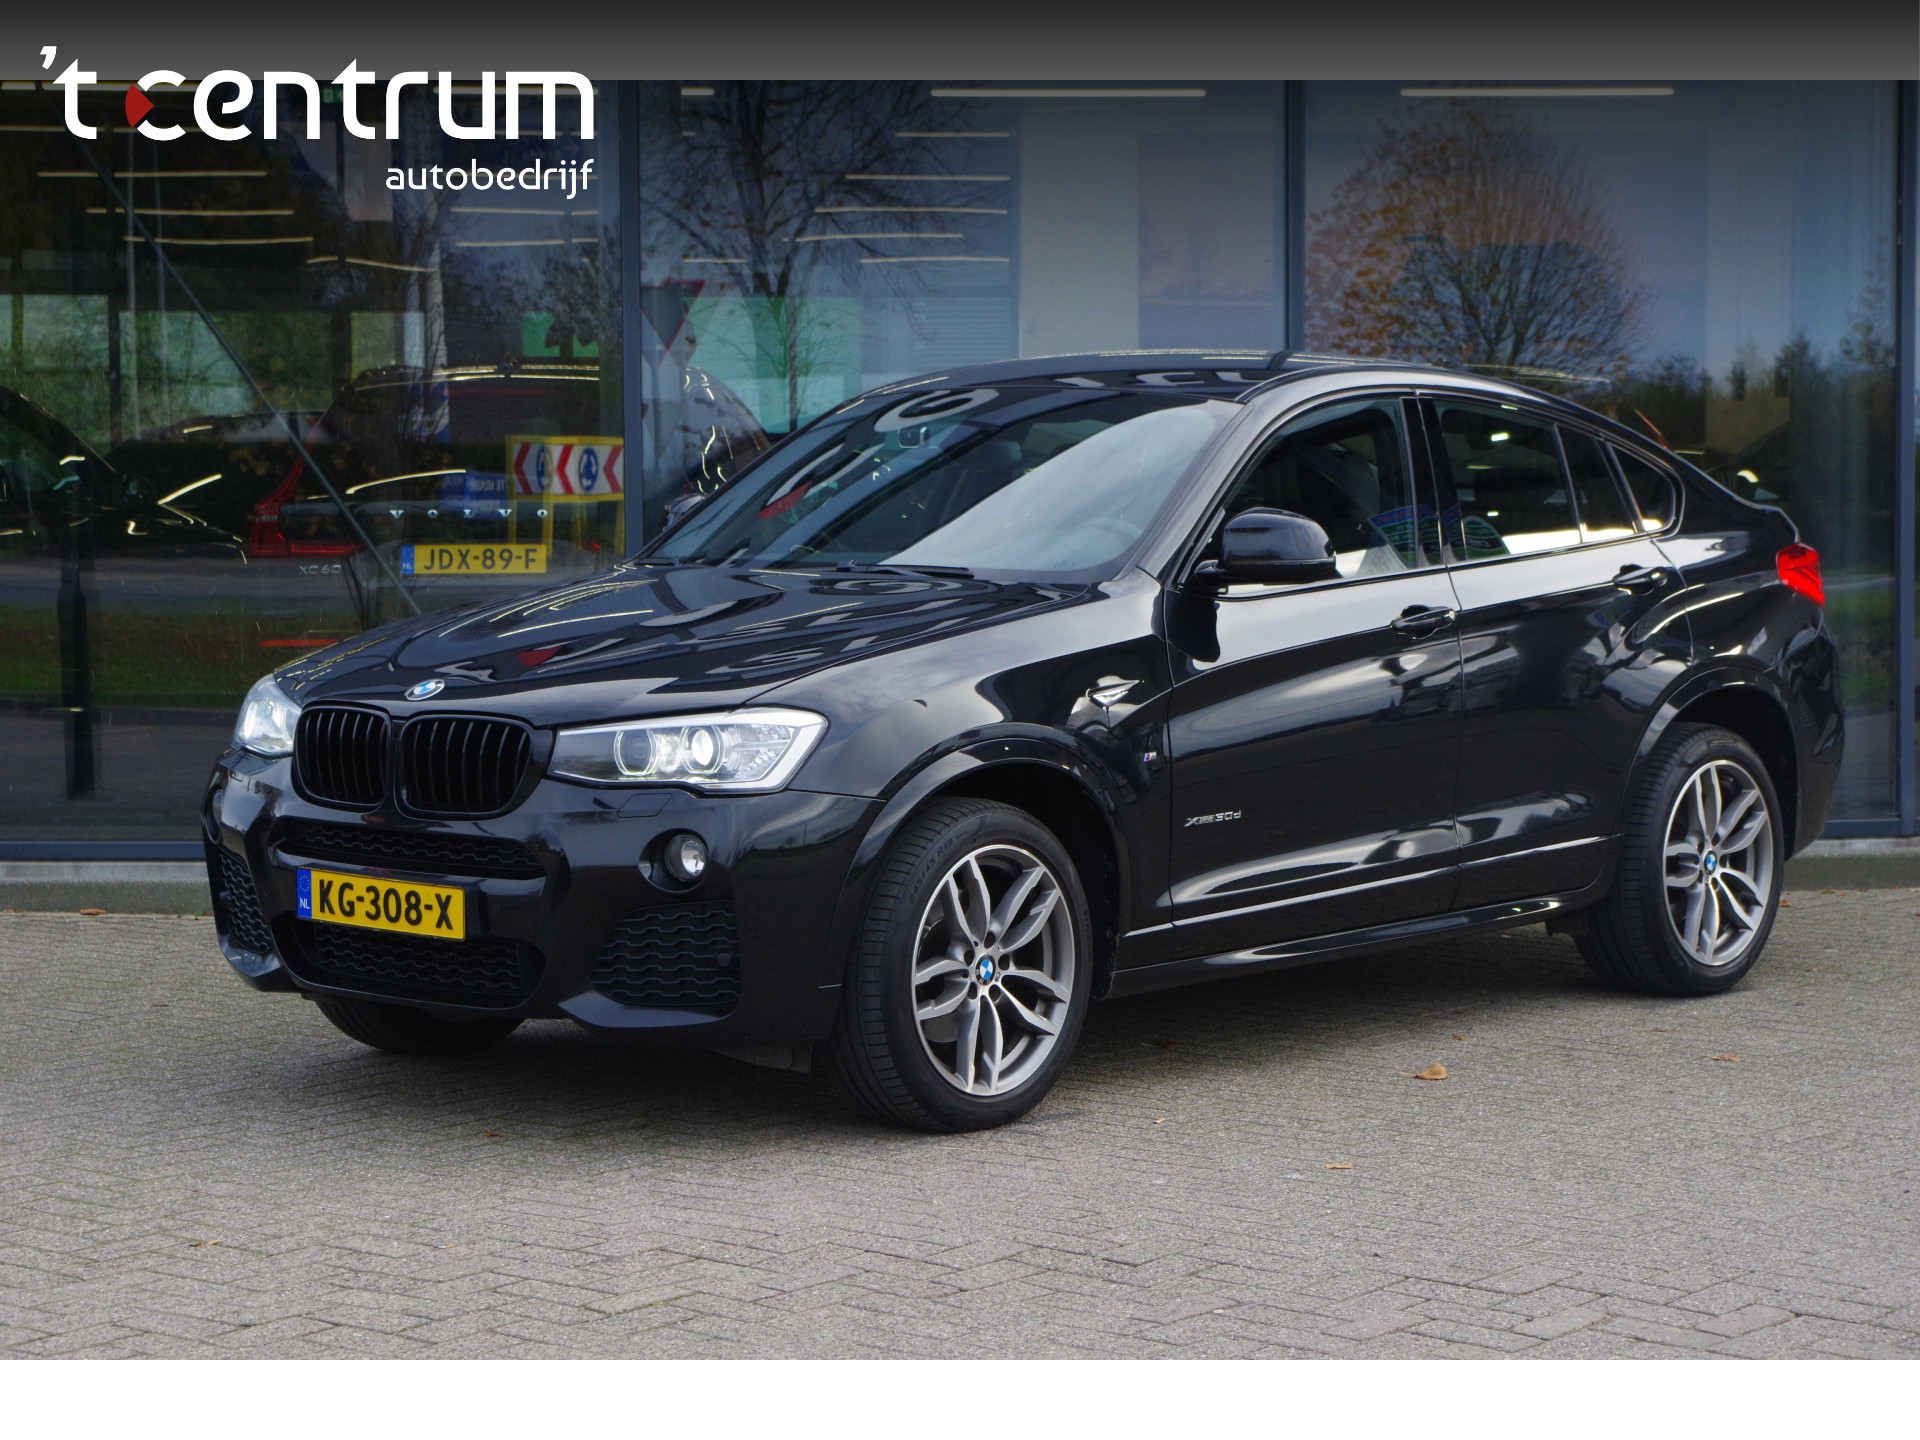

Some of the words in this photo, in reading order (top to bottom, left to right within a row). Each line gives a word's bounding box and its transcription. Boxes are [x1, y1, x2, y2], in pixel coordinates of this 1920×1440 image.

[390, 508, 548, 519] VOLVO
[402, 561, 412, 570] NL
[423, 547, 538, 571] JDX-89-F
[299, 897, 311, 910] NL
[319, 878, 454, 931] KG-308-X
